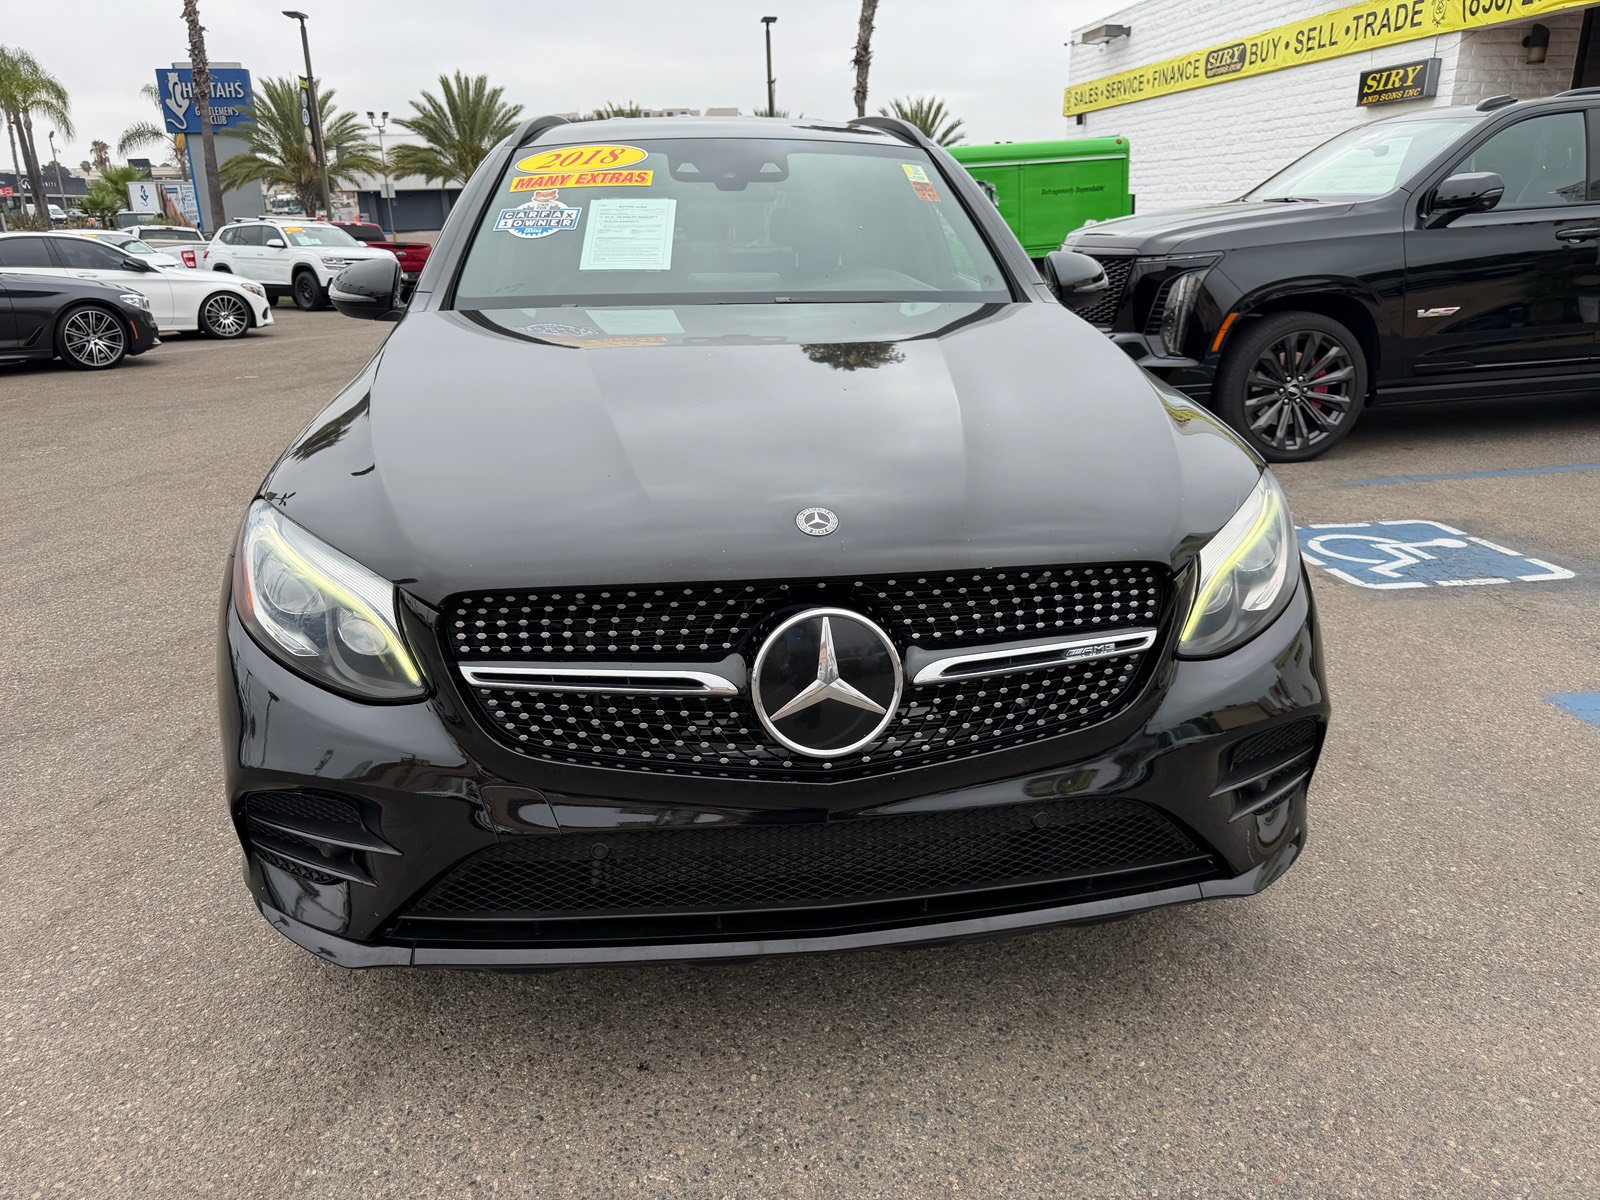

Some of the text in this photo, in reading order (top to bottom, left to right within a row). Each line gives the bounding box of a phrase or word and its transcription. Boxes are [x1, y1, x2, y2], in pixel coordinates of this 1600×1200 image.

[1249, 0, 1425, 65] BUY SELL TRADE
[1207, 45, 1246, 69] SIRY
[1073, 59, 1201, 107] SALES SERVICE FINANCE
[1362, 65, 1424, 94] SIRY
[1361, 87, 1422, 105] AND SONS INC
[210, 115, 227, 125] CLUB
[535, 148, 626, 170] 2018
[513, 171, 649, 191] MANY EXTRAS
[501, 219, 573, 228] 1 OWNER
[504, 210, 575, 219] CARFAX
